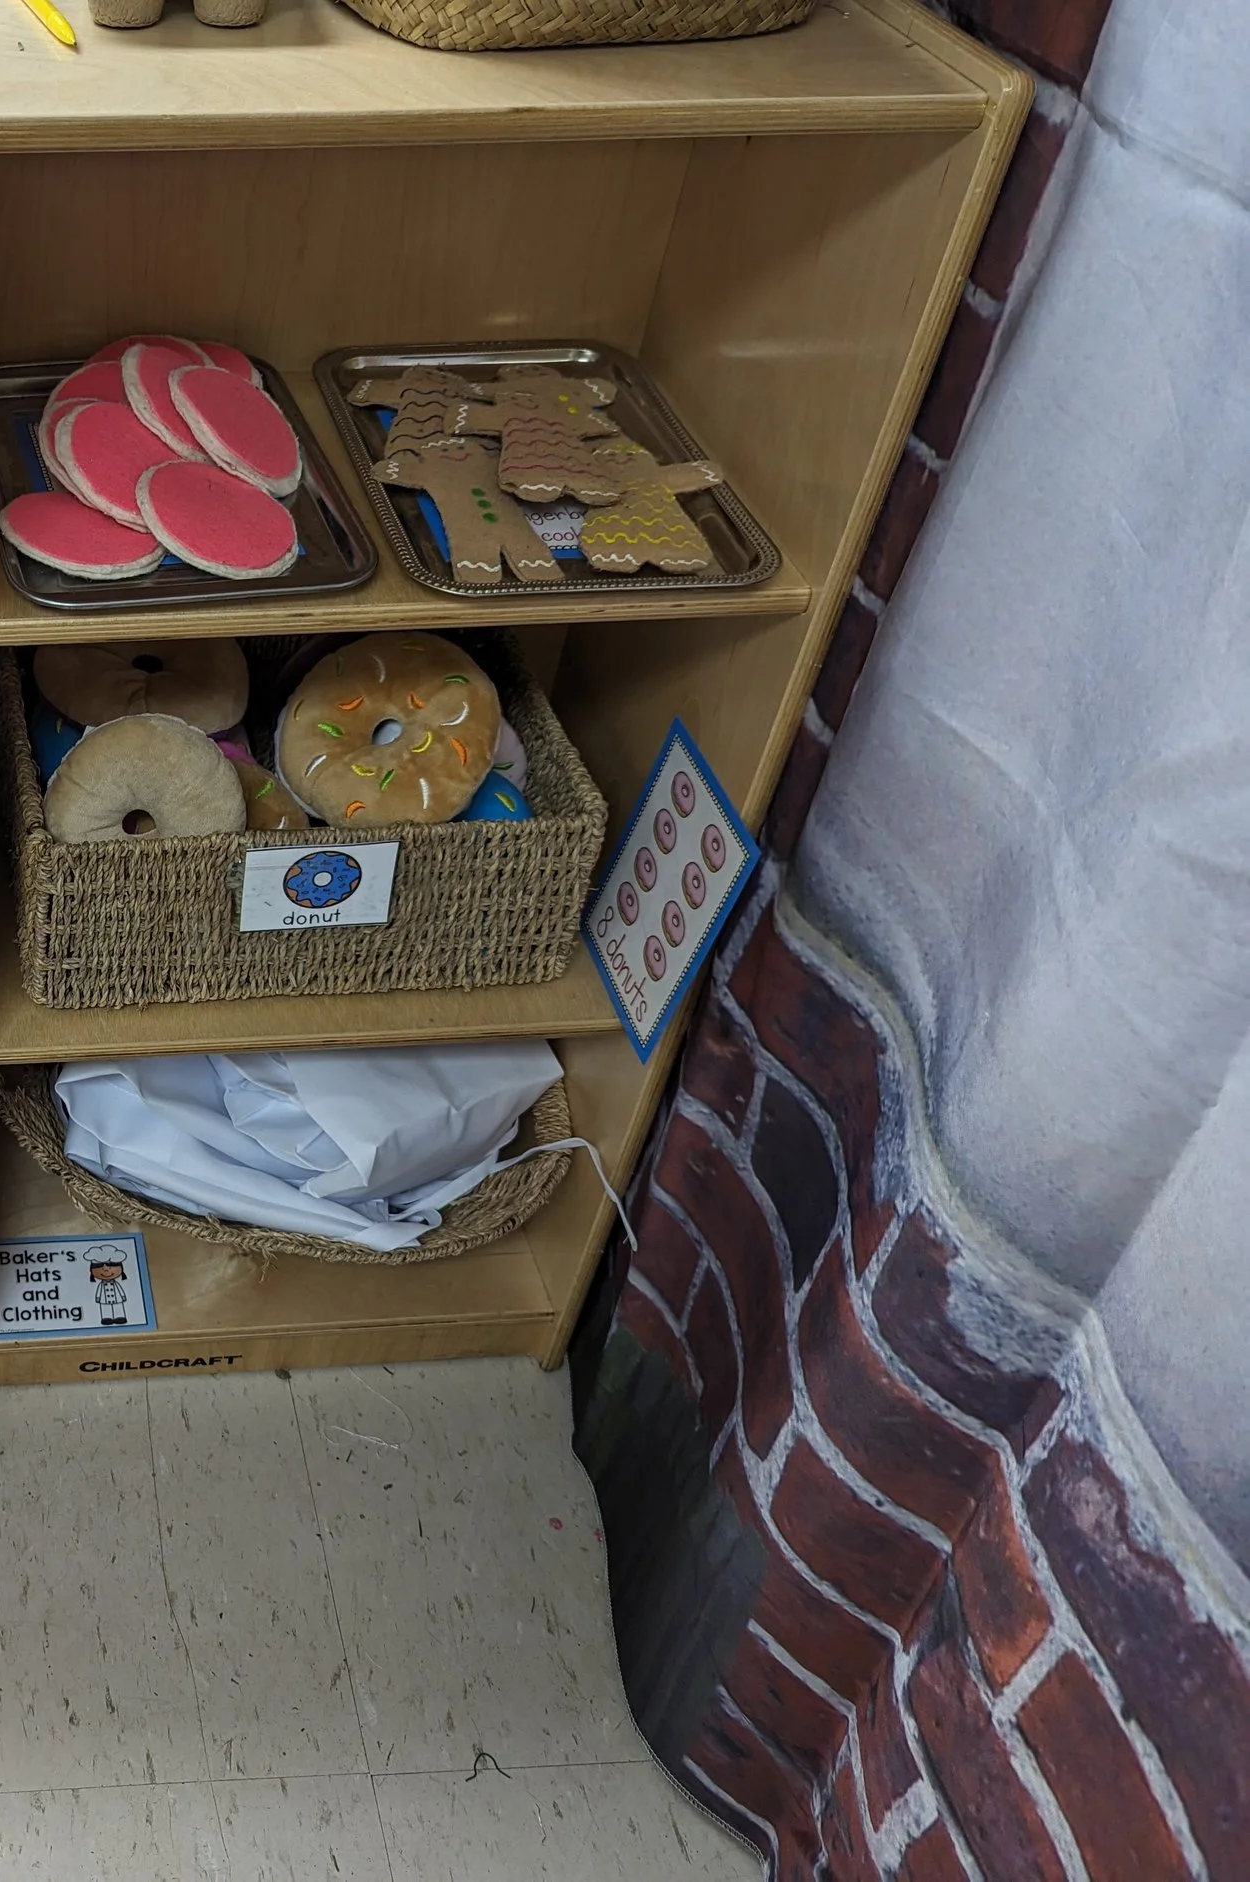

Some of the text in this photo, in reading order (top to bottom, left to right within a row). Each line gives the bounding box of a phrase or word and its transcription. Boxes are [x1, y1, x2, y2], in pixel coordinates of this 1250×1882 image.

[282, 909, 341, 925] donut
[596, 905, 648, 1023] 8 donuts
[0, 1250, 76, 1265] Baker's
[16, 1267, 62, 1283] Hats
[22, 1285, 60, 1302] and
[2, 1305, 83, 1322] Clothing
[79, 1356, 241, 1373] CHILDCRAFT
